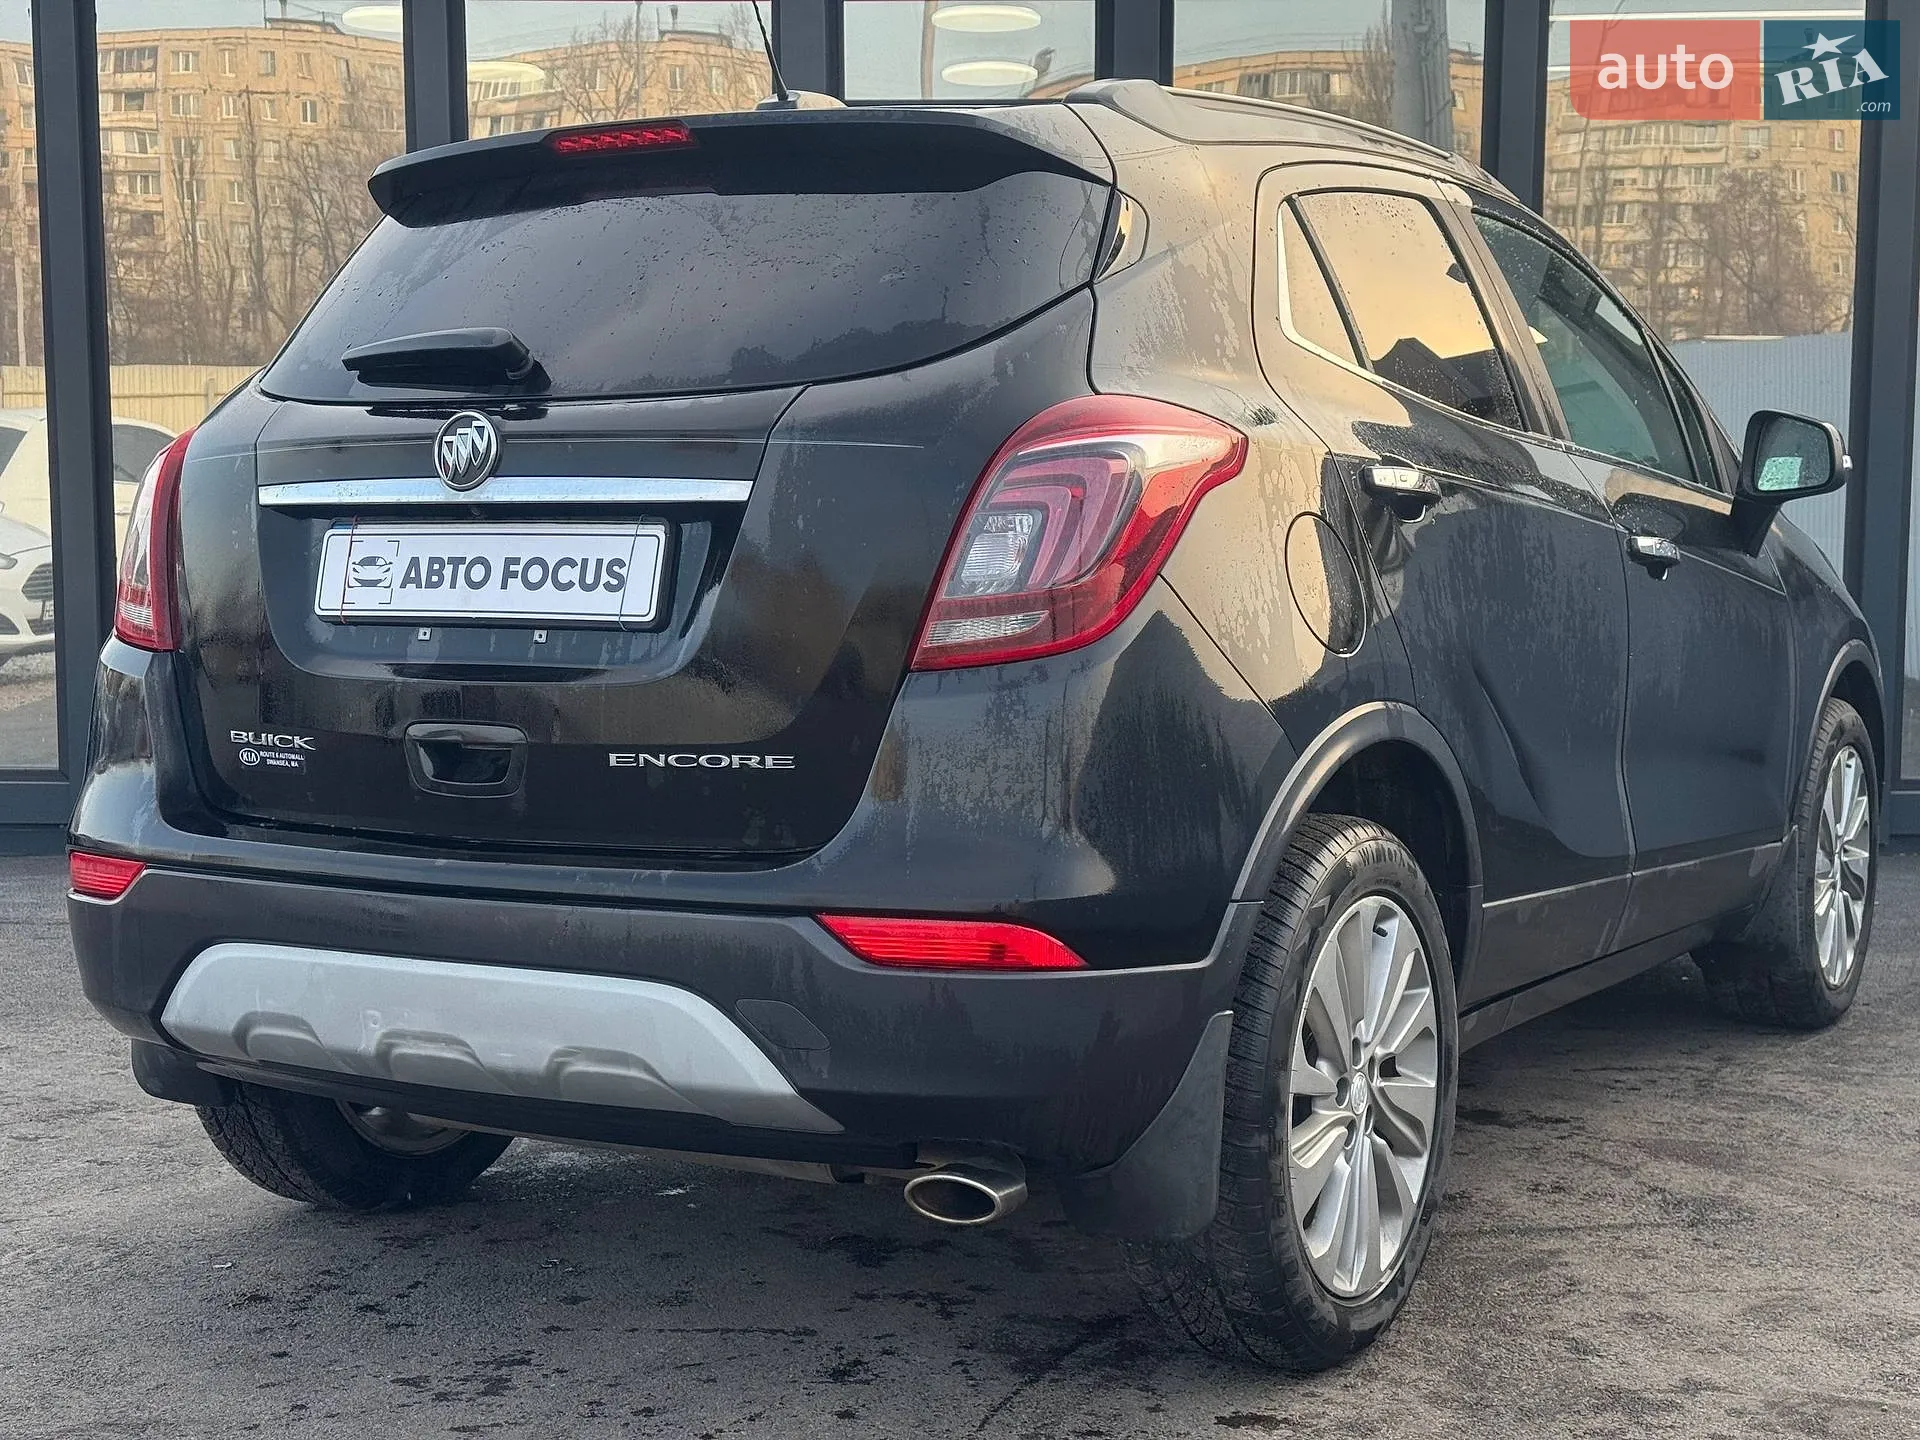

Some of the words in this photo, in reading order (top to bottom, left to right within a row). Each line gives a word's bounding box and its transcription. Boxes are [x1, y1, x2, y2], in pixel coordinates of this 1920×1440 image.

[500, 556, 627, 593] FOCUS
[230, 730, 316, 751] BUICK
[609, 753, 796, 769] ENCORE
